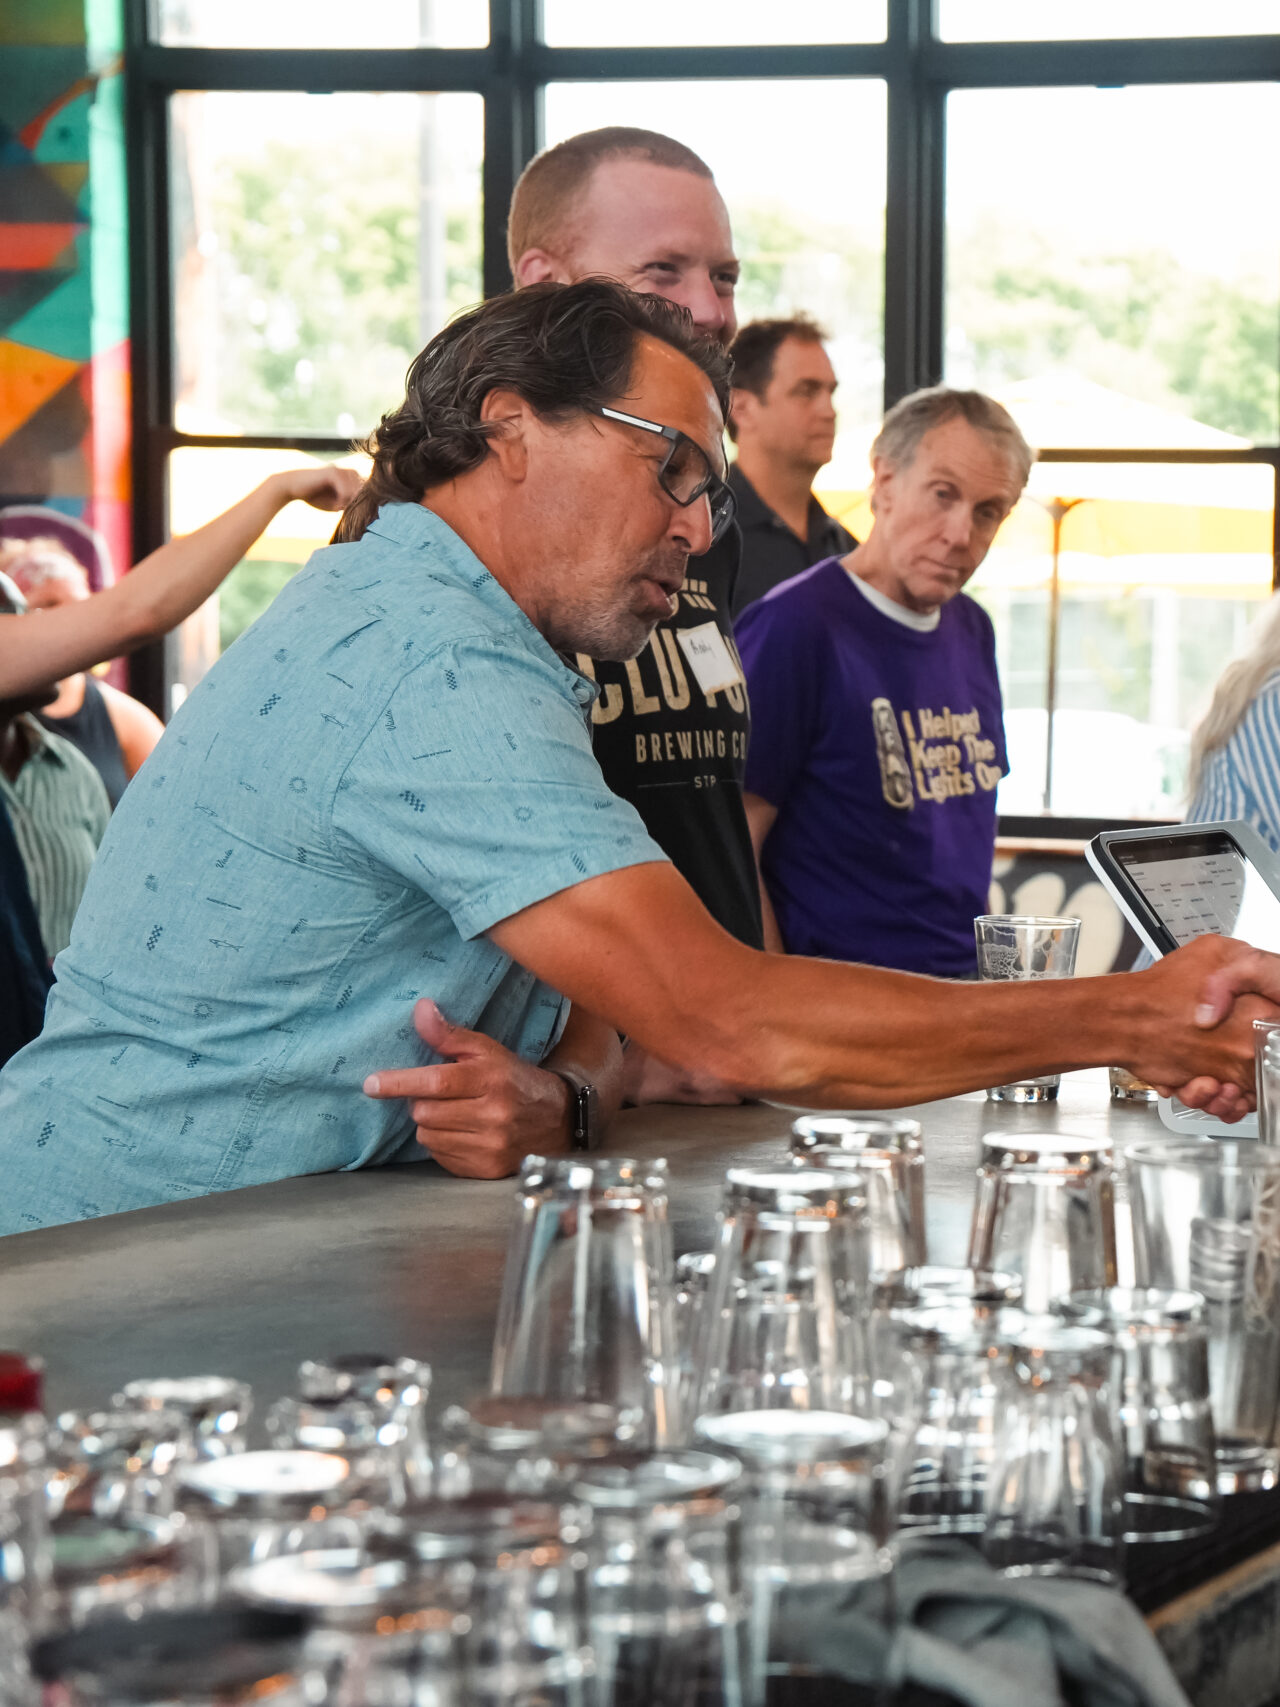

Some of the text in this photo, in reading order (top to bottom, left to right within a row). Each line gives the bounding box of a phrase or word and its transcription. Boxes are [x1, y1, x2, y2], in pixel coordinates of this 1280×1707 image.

[577, 628, 750, 725] CLU
[902, 706, 980, 742] I Helped
[635, 729, 726, 763] BREWING
[908, 734, 995, 771] Keep The
[694, 775, 717, 788] STP
[914, 765, 976, 804] Lights
